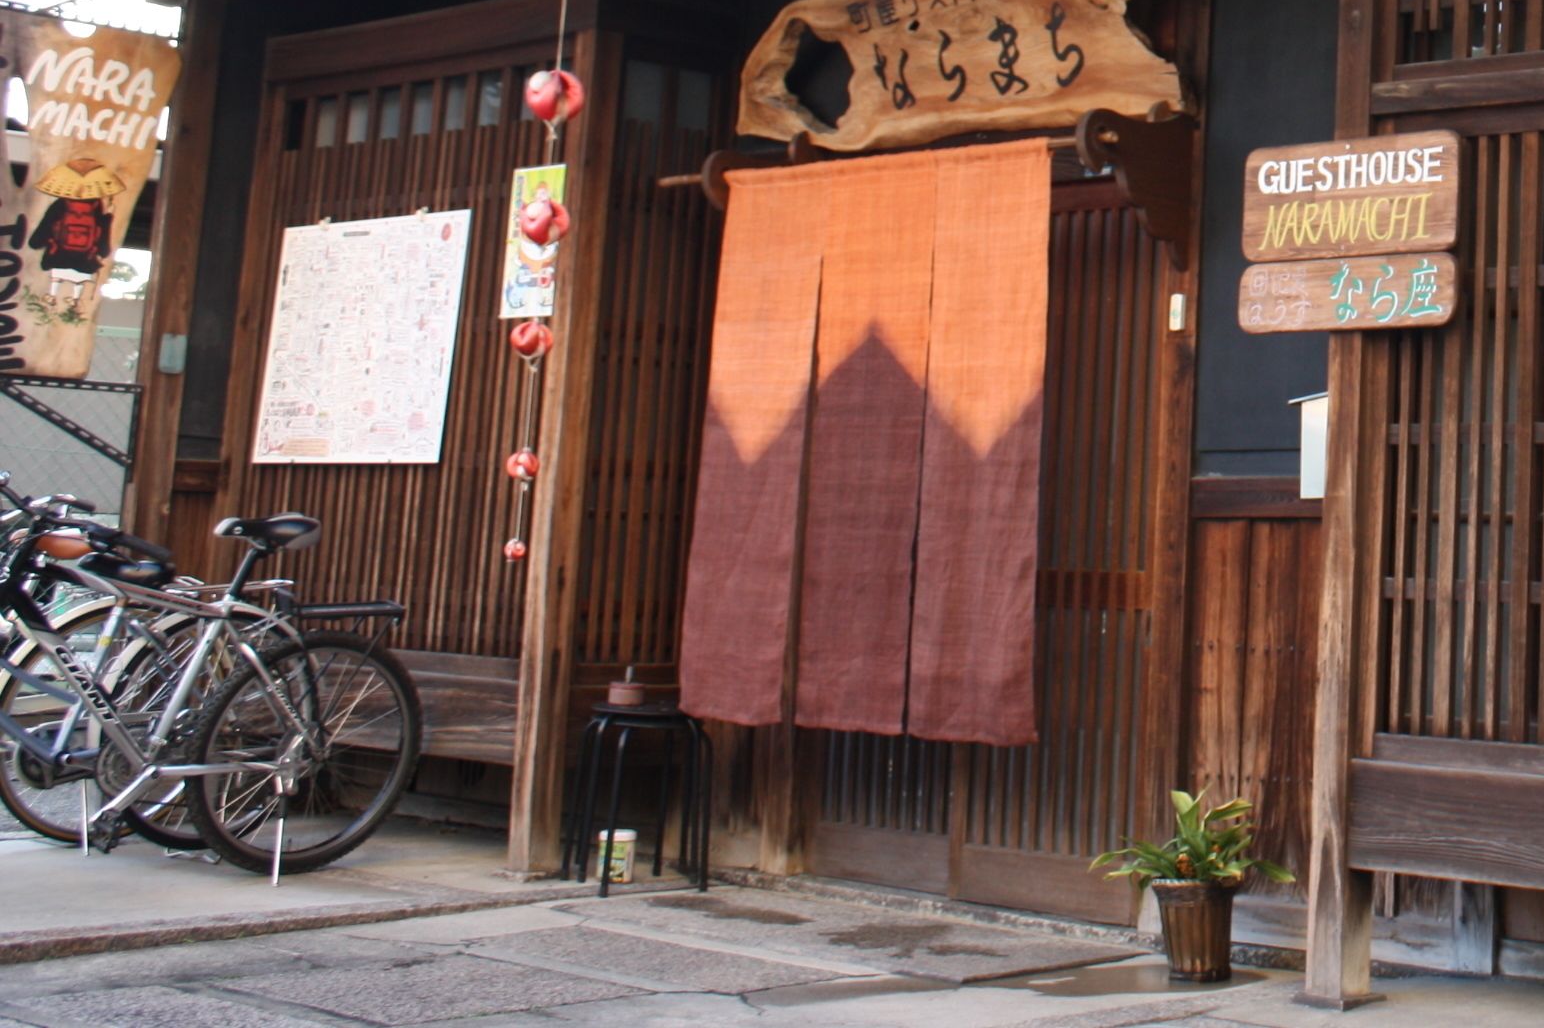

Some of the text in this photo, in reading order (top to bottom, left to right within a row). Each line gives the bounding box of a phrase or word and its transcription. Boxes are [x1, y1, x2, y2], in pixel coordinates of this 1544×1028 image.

[27, 46, 156, 111] NARA
[873, 2, 1085, 110] ならまち
[29, 99, 157, 150] MACHI
[1257, 146, 1443, 195] GUESTHOUSE
[1259, 194, 1433, 251] NARAMACHI
[1330, 259, 1443, 324] なら座
